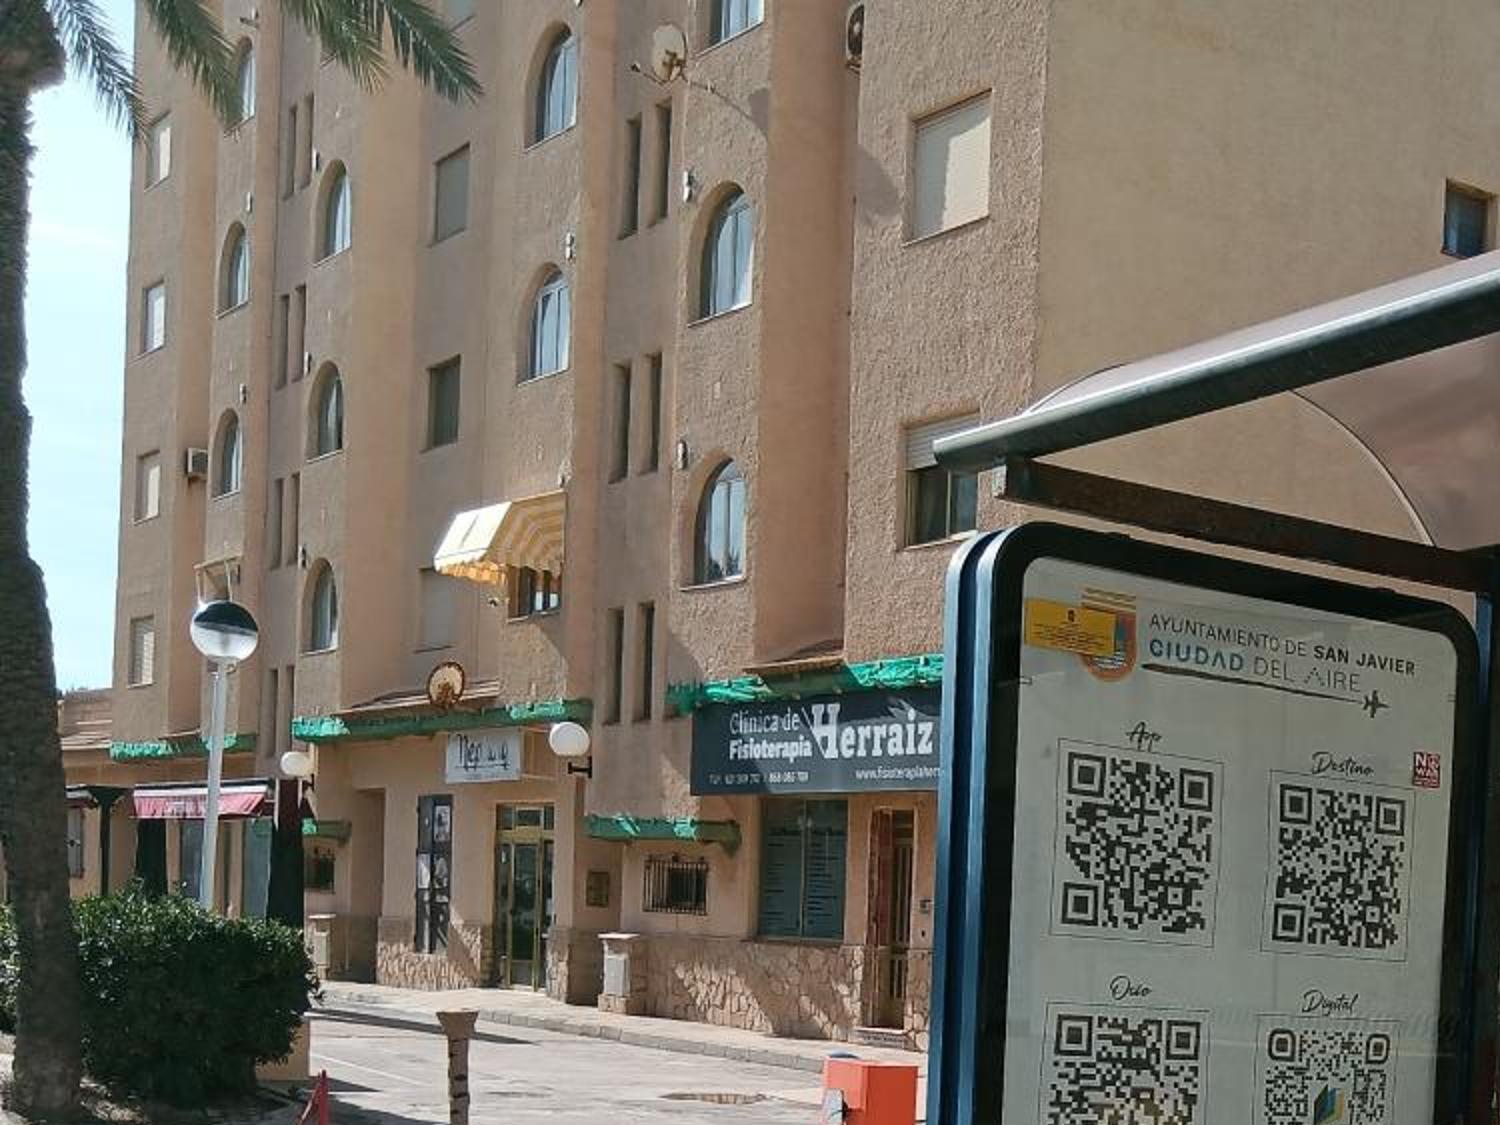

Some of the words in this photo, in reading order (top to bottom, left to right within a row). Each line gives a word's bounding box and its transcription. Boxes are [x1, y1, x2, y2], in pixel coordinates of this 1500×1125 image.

[1149, 613, 1280, 652] AYUNTAMIENTO
[1285, 639, 1307, 657] DE
[1313, 645, 1349, 664] SAN
[1356, 652, 1416, 676] JAVIER
[1149, 639, 1244, 671] CIUDAD
[1253, 657, 1296, 683] DEL
[1303, 667, 1362, 692] AIRE
[729, 708, 780, 734] Clínica
[782, 707, 800, 731] de
[803, 703, 934, 759] Herraiz
[729, 736, 813, 763] Fisioterapia
[1125, 721, 1162, 751] App
[1311, 751, 1375, 777] Destino
[1302, 989, 1360, 1017] Digital
